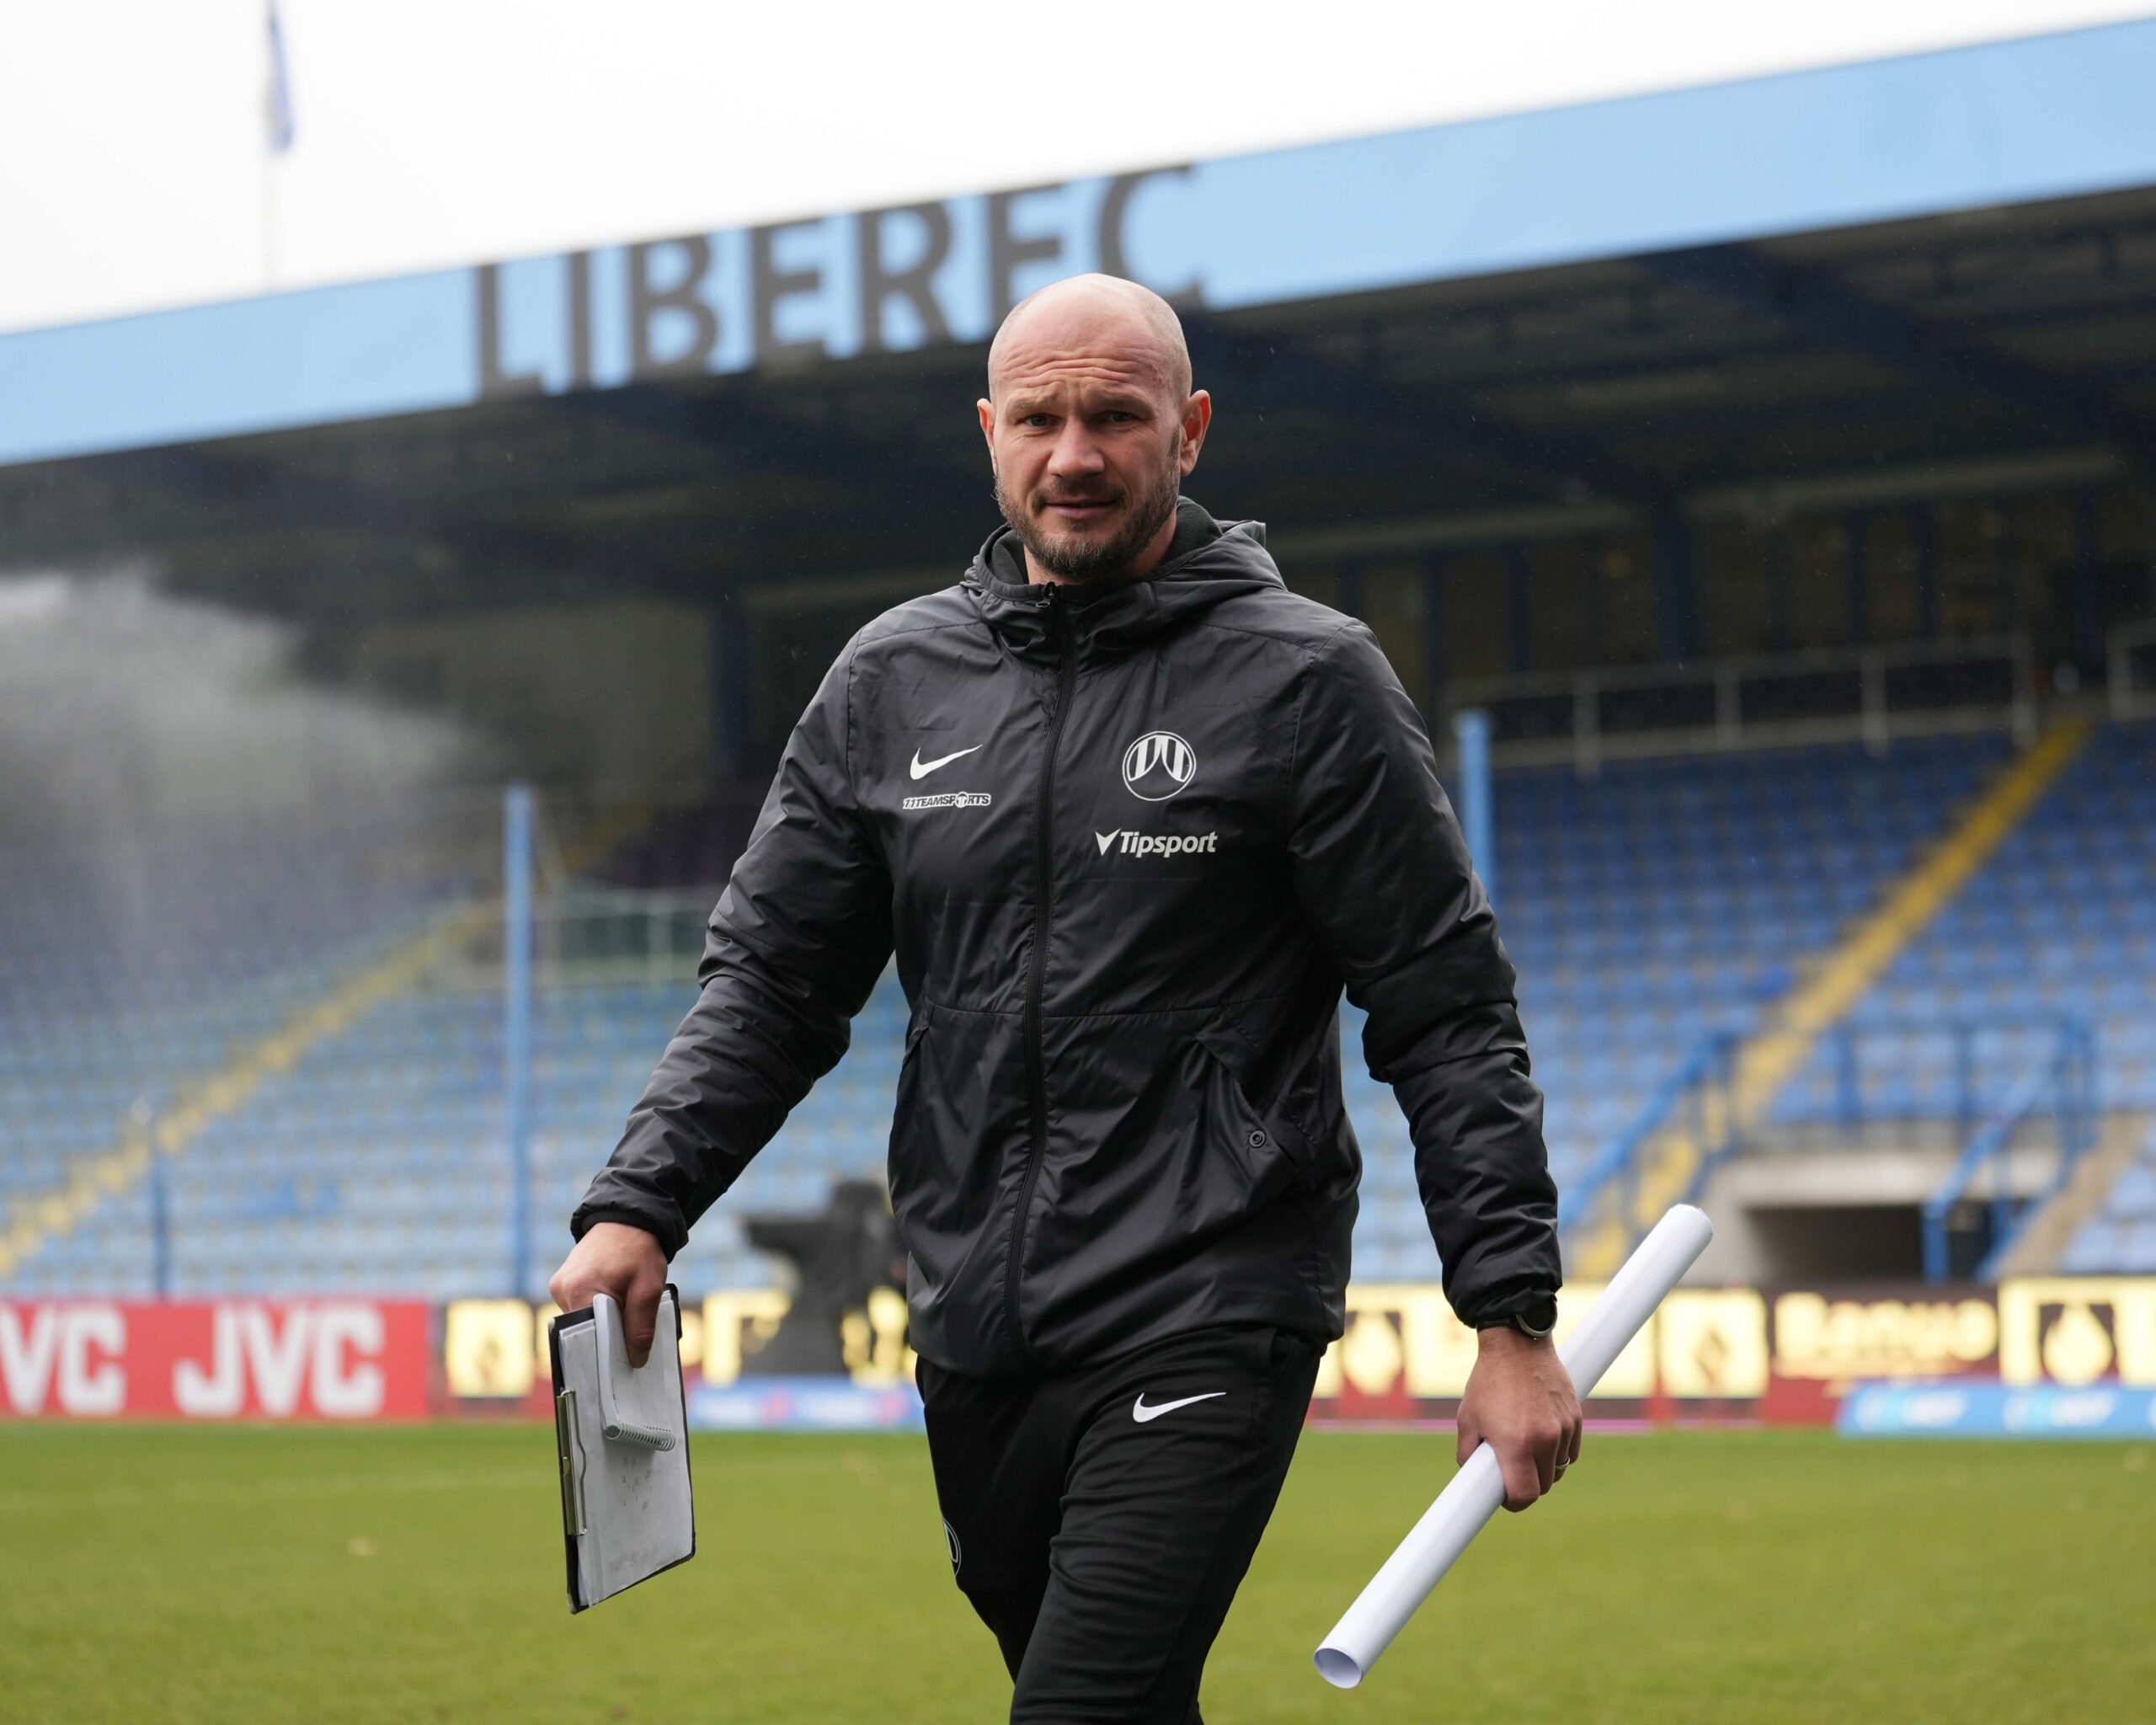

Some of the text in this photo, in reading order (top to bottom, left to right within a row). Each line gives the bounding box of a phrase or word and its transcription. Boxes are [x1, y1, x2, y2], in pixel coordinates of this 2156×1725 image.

[476, 166, 1204, 399] LIBEREC
[1120, 831, 1218, 858] Tipsport
[173, 1306, 385, 1416] JVC
